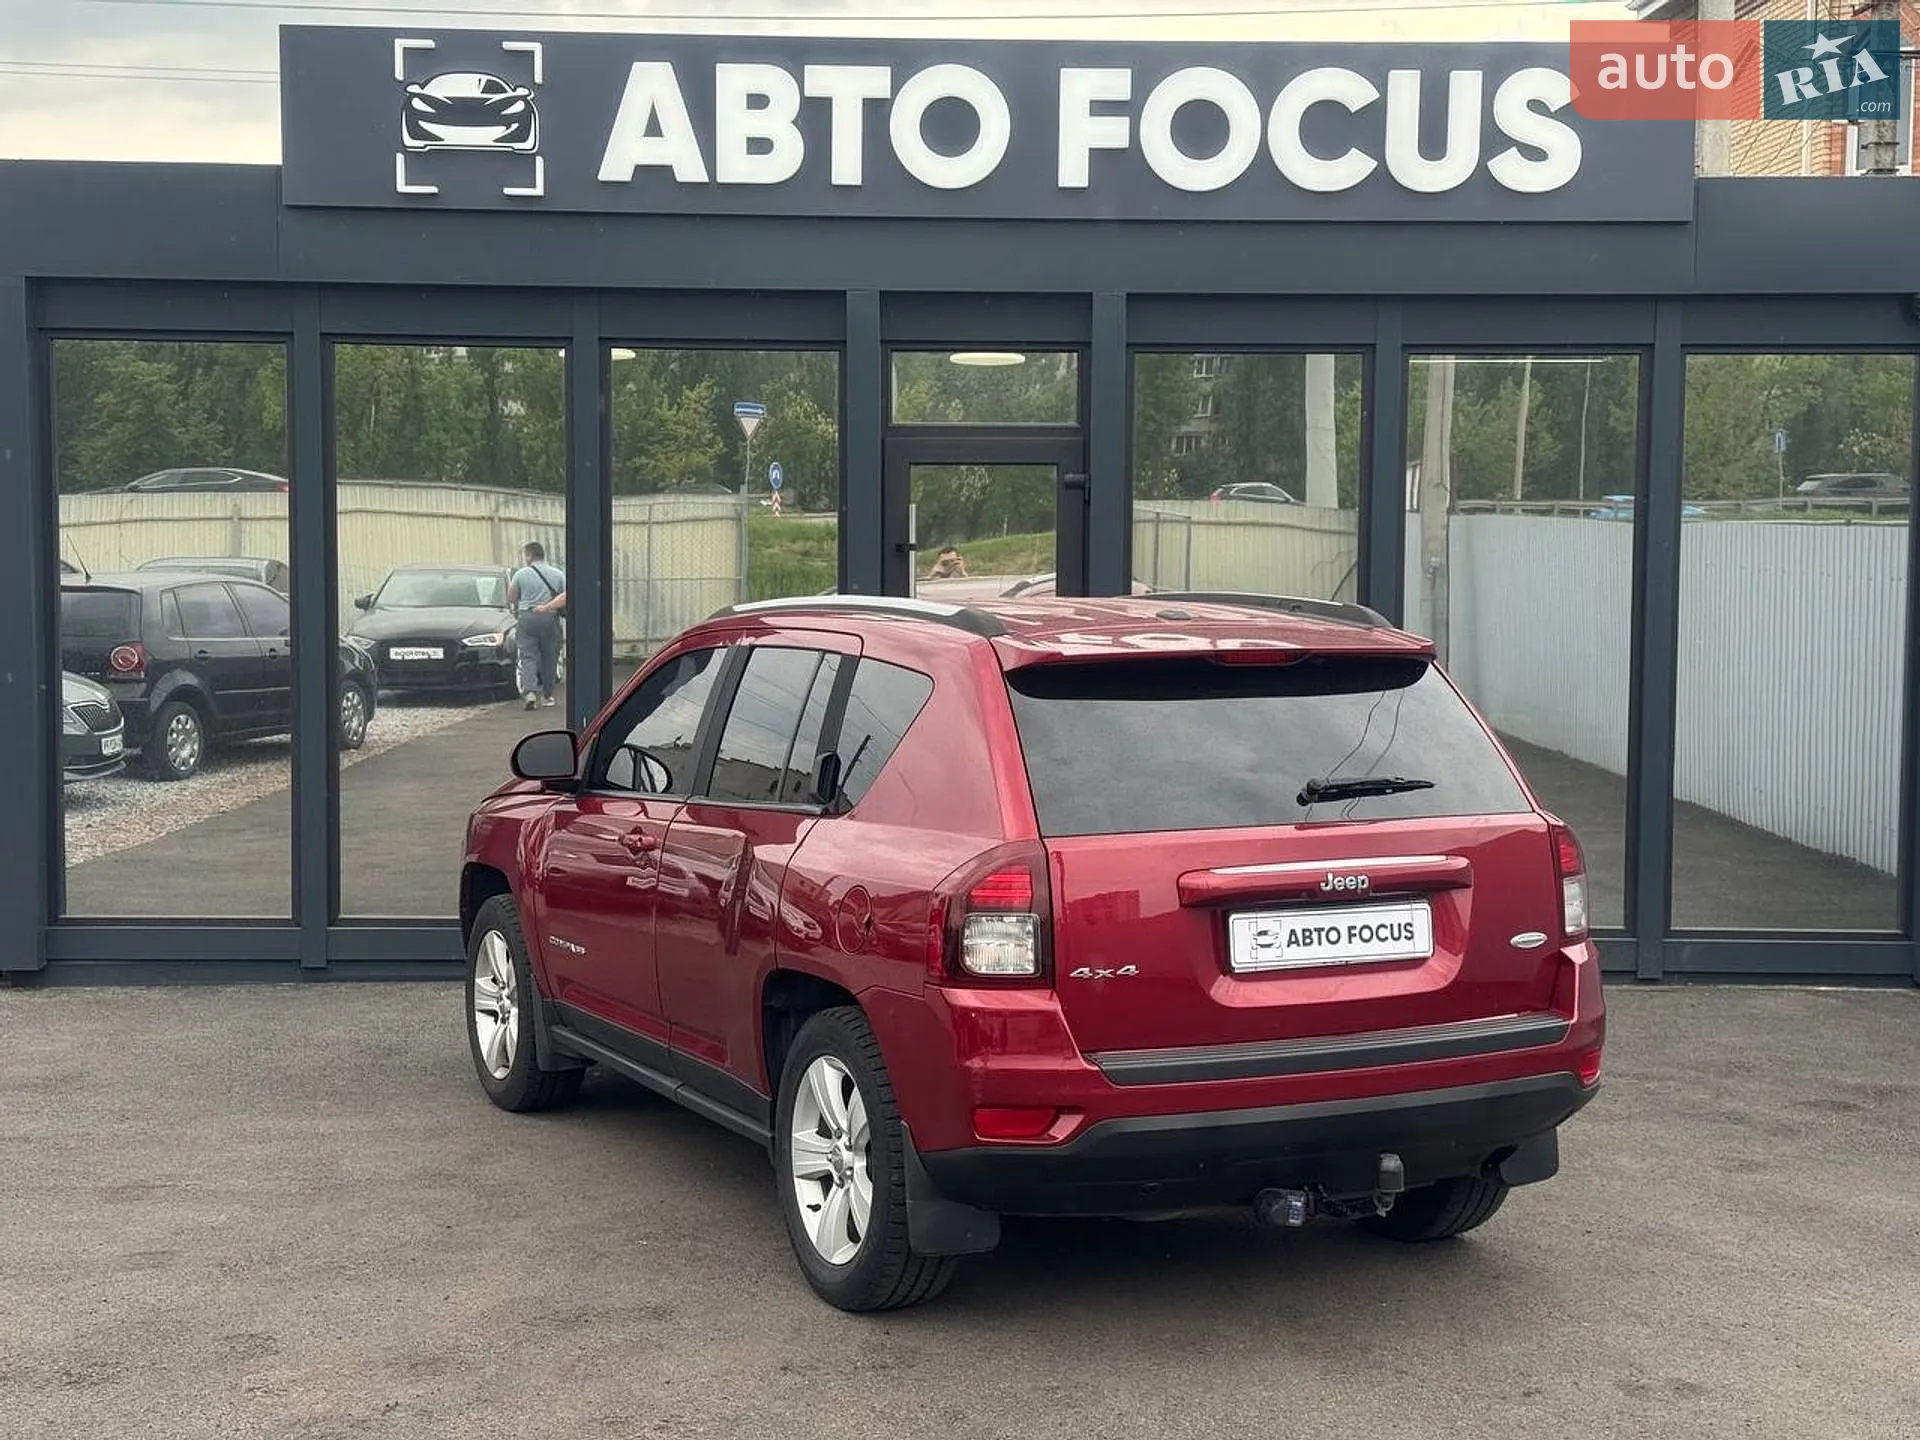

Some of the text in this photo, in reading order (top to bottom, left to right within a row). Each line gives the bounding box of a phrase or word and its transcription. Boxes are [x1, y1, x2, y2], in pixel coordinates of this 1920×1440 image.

[597, 60, 1583, 194] АВТО FOCUS
[1319, 872, 1370, 892] Jeep
[1286, 921, 1415, 949] АВТО FOCUS
